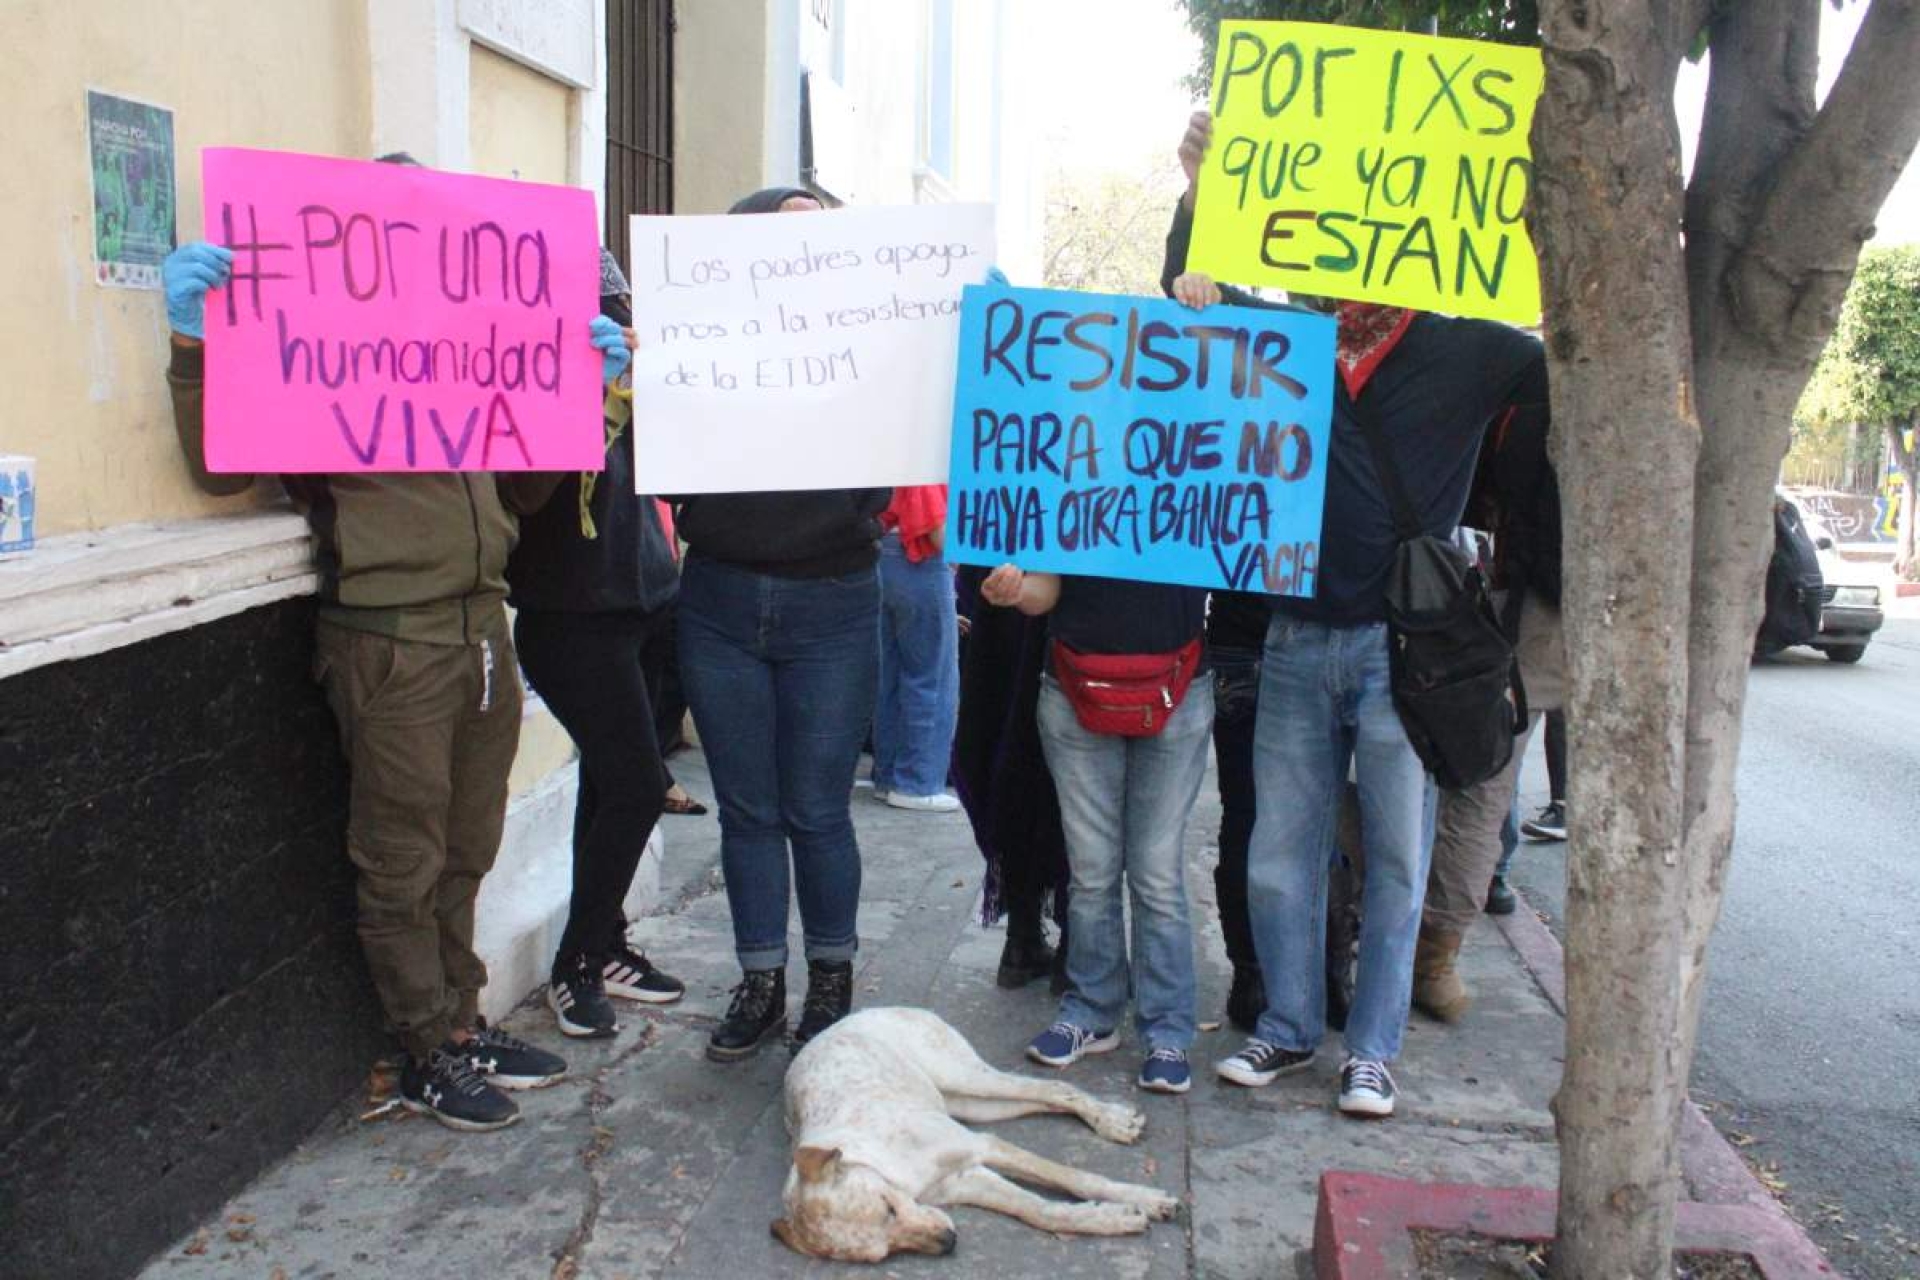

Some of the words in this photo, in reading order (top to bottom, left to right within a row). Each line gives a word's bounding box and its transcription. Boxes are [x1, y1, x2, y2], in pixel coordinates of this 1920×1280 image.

[1222, 136, 1322, 211] que
[1356, 146, 1426, 216] ya
[1451, 154, 1536, 229] NO
[438, 220, 551, 308] una
[655, 233, 731, 291] Los
[750, 240, 862, 299] padres
[1260, 210, 1510, 299] ESTAN
[276, 308, 563, 396] humanidad
[660, 320, 728, 343] mos
[742, 319, 761, 335] a
[777, 303, 808, 333] la
[982, 299, 1308, 400] RESISTIR
[664, 362, 699, 386] de
[710, 360, 738, 390] la
[330, 392, 533, 468] VIVA
[972, 408, 1104, 483] PARA
[1122, 417, 1225, 480] QUE
[1236, 419, 1313, 482] NO
[957, 485, 1048, 556] HAYA
[1056, 485, 1143, 555] OTRA
[1150, 481, 1274, 549] BANCA
[1210, 541, 1319, 597] VACIA
